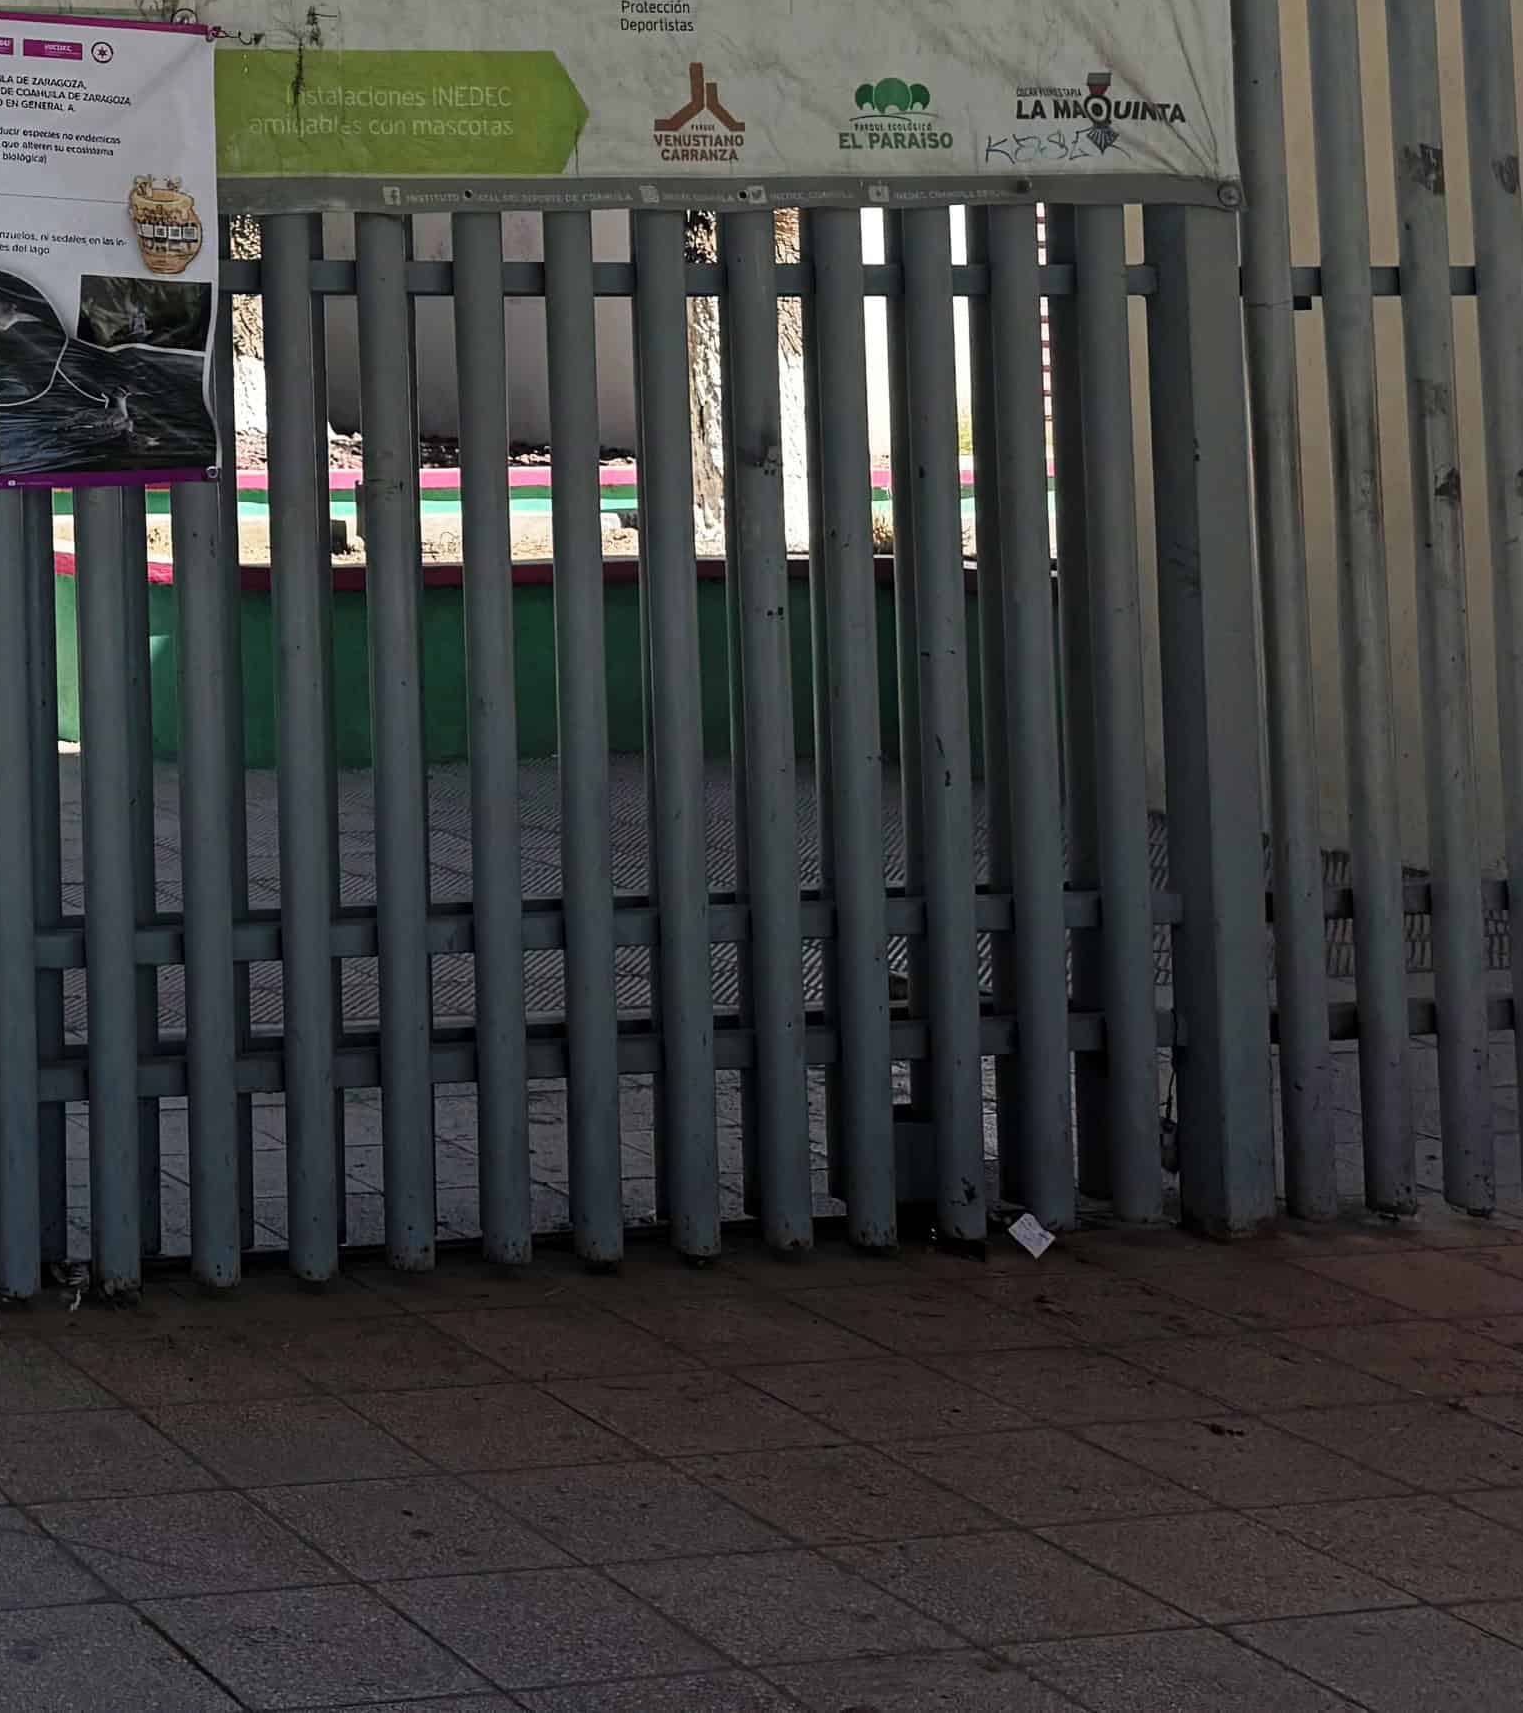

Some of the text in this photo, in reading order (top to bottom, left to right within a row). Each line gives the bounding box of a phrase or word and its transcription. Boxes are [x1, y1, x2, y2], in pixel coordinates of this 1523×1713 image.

[621, 0, 689, 14] Protección
[620, 18, 693, 34] Deportistas
[17, 76, 29, 85] DE
[1, 87, 13, 95] DE
[16, 87, 65, 100] COAHUILA
[68, 91, 81, 101] DE
[432, 86, 512, 107] INEDEC
[6, 99, 18, 107] EN
[21, 100, 64, 111] GENERAL
[1016, 100, 1046, 120] LA
[369, 119, 406, 135] con
[412, 117, 513, 135] mascotas
[23, 129, 60, 140] especies
[62, 133, 73, 141] no
[653, 134, 744, 146] VENUSTIANO
[839, 132, 863, 149] EL
[2, 140, 20, 149] que
[23, 140, 52, 151] alteren
[55, 144, 64, 152] su
[66, 145, 113, 156] ecosistema
[661, 148, 739, 161] CARRANZA
[41, 232, 49, 241] ni
[89, 237, 101, 246] en
[103, 237, 114, 246] las
[12, 244, 27, 253] del
[30, 244, 50, 255] lago
